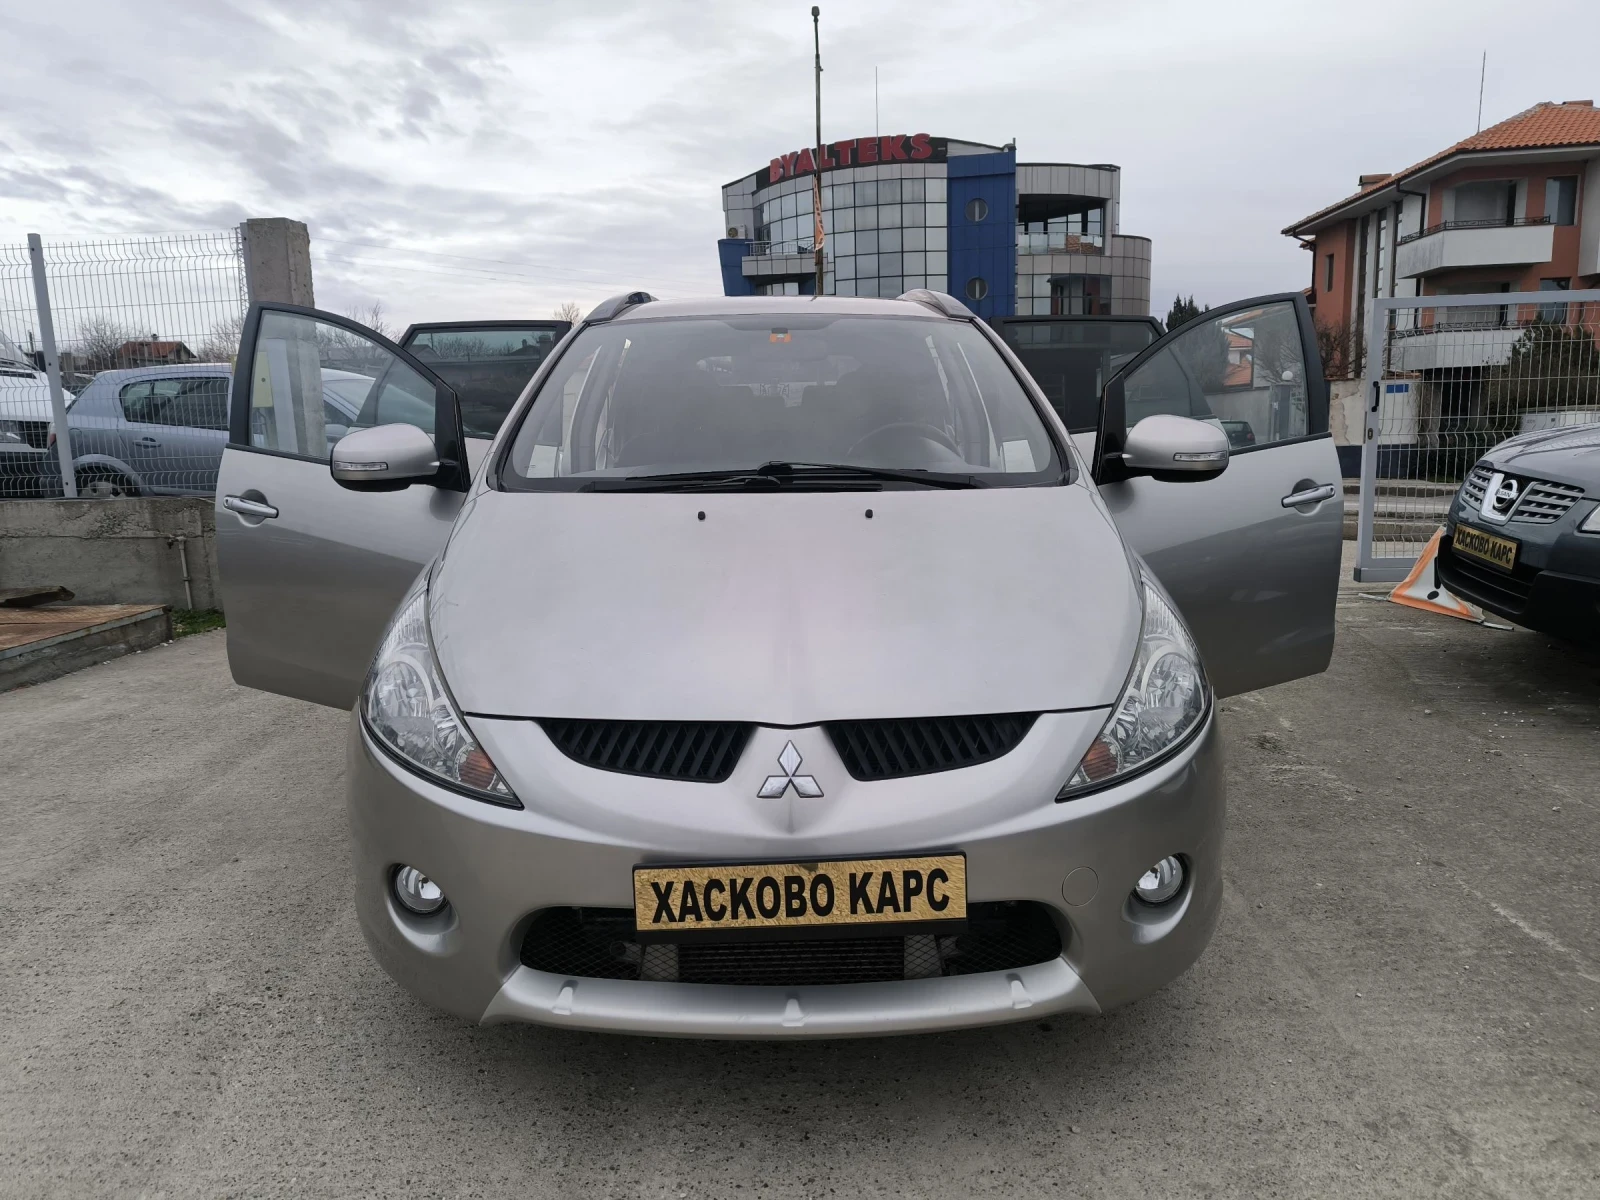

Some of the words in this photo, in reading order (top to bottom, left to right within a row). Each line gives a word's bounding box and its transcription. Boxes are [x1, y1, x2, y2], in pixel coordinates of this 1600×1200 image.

[769, 133, 933, 183] BYALTEKS
[1455, 528, 1489, 555] ХАСКОВО
[1490, 540, 1513, 565] КАРС
[651, 873, 835, 923] ХАСКОВО
[849, 868, 949, 914] КАРС
